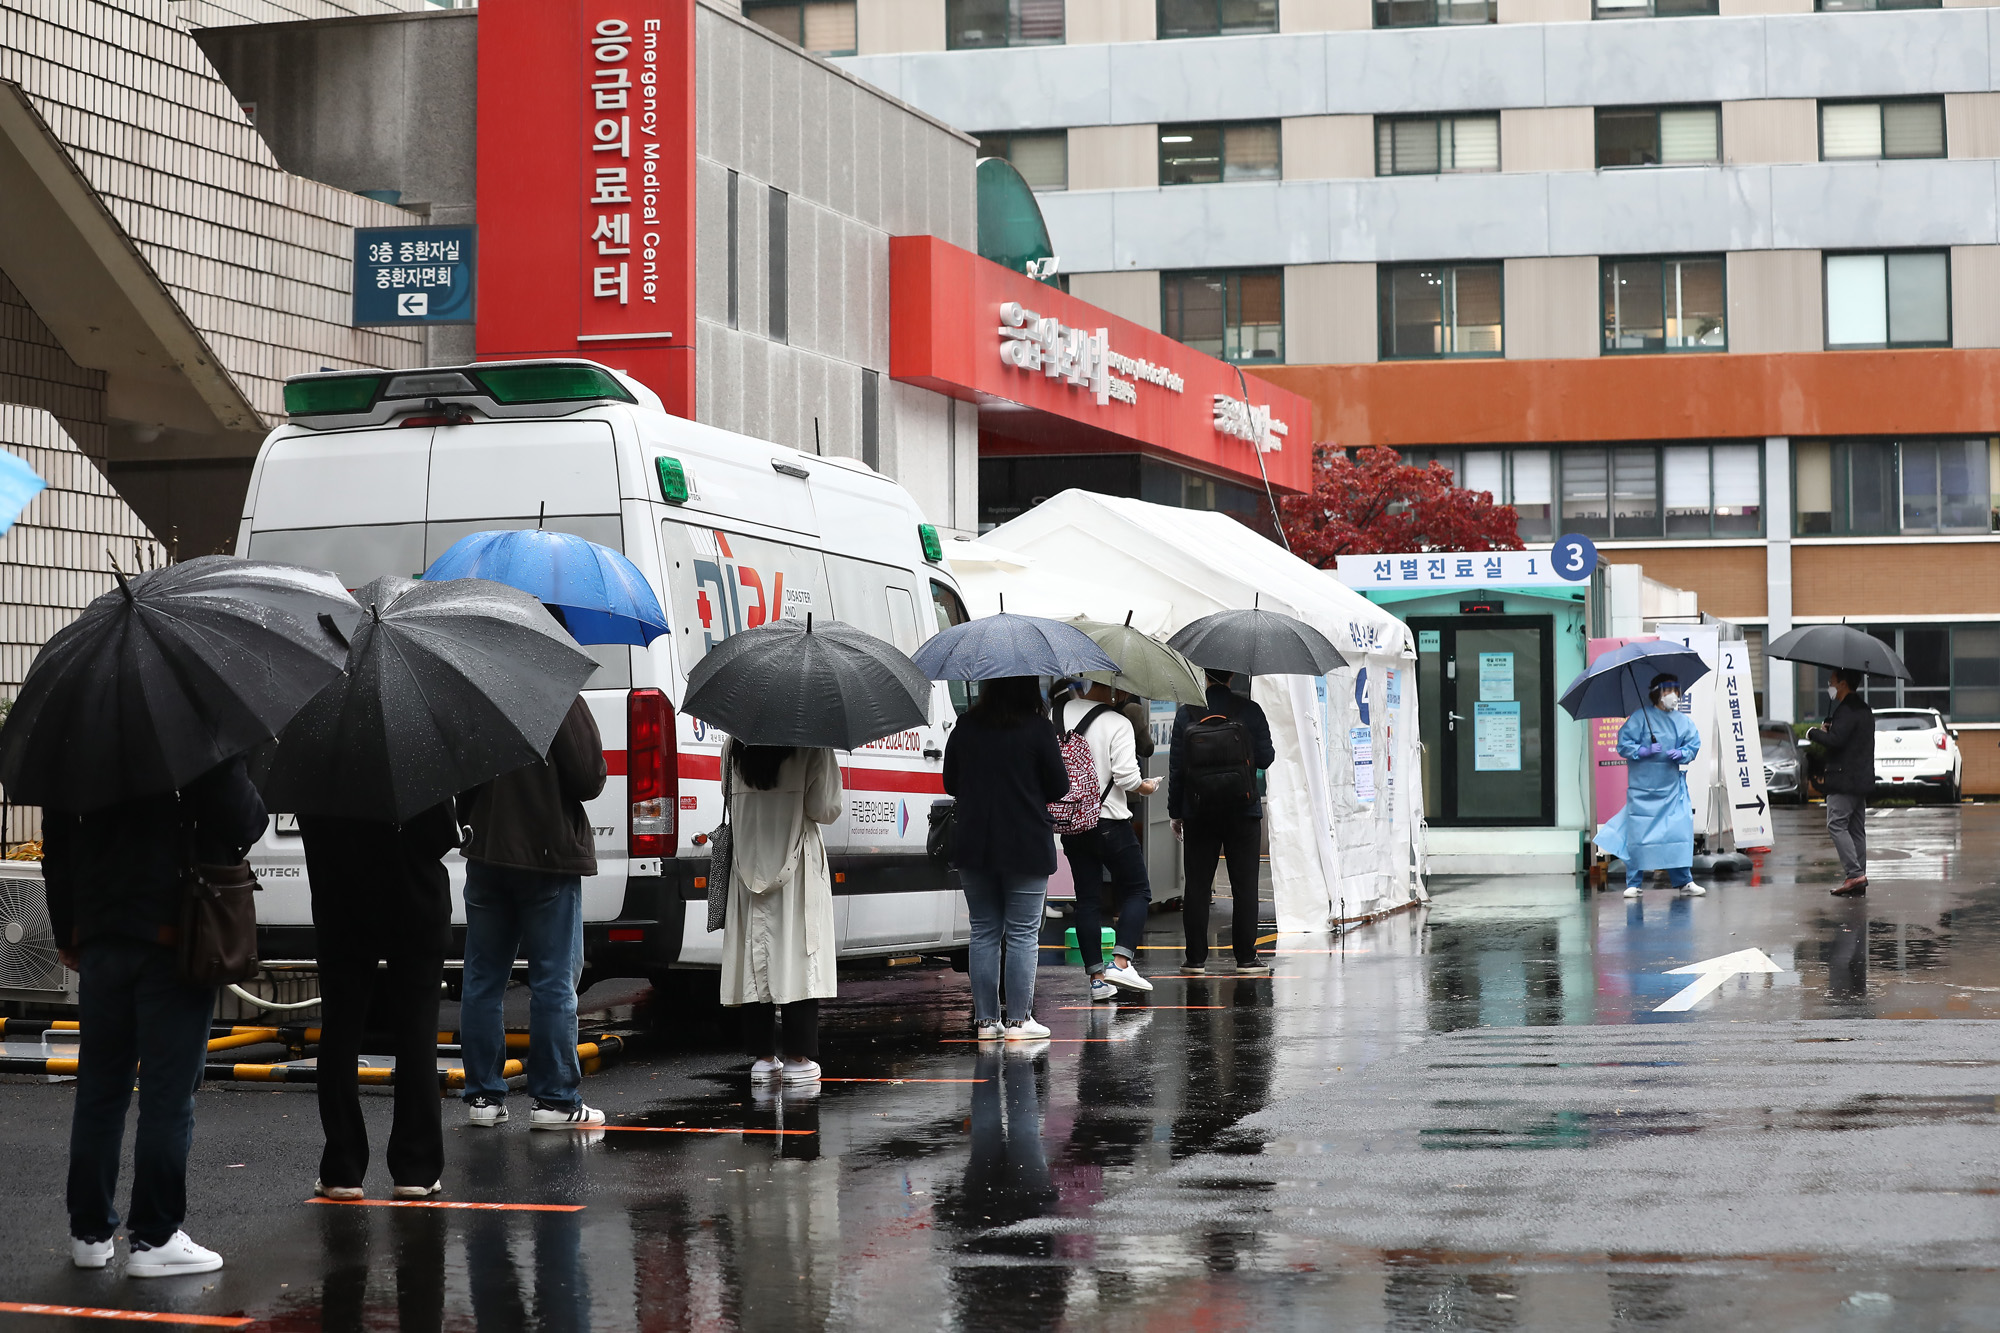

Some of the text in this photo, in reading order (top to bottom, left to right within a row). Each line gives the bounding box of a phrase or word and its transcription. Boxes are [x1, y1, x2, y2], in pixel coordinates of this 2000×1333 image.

[590, 18, 632, 305] 응급의료센터
[641, 19, 661, 303] Emergency Medical Center
[368, 240, 460, 263] 3층 중환자실
[376, 266, 452, 289] 중환자면회
[998, 301, 1109, 406] 응급의료센터
[1373, 557, 1538, 581] 선별진료실 1
[1565, 543, 1585, 572] 3
[786, 589, 811, 603] DISASTER
[785, 605, 796, 618] AND
[1725, 653, 1734, 670] 2
[1726, 675, 1751, 788] 선별진료실
[851, 801, 896, 823] 국립중앙의료원
